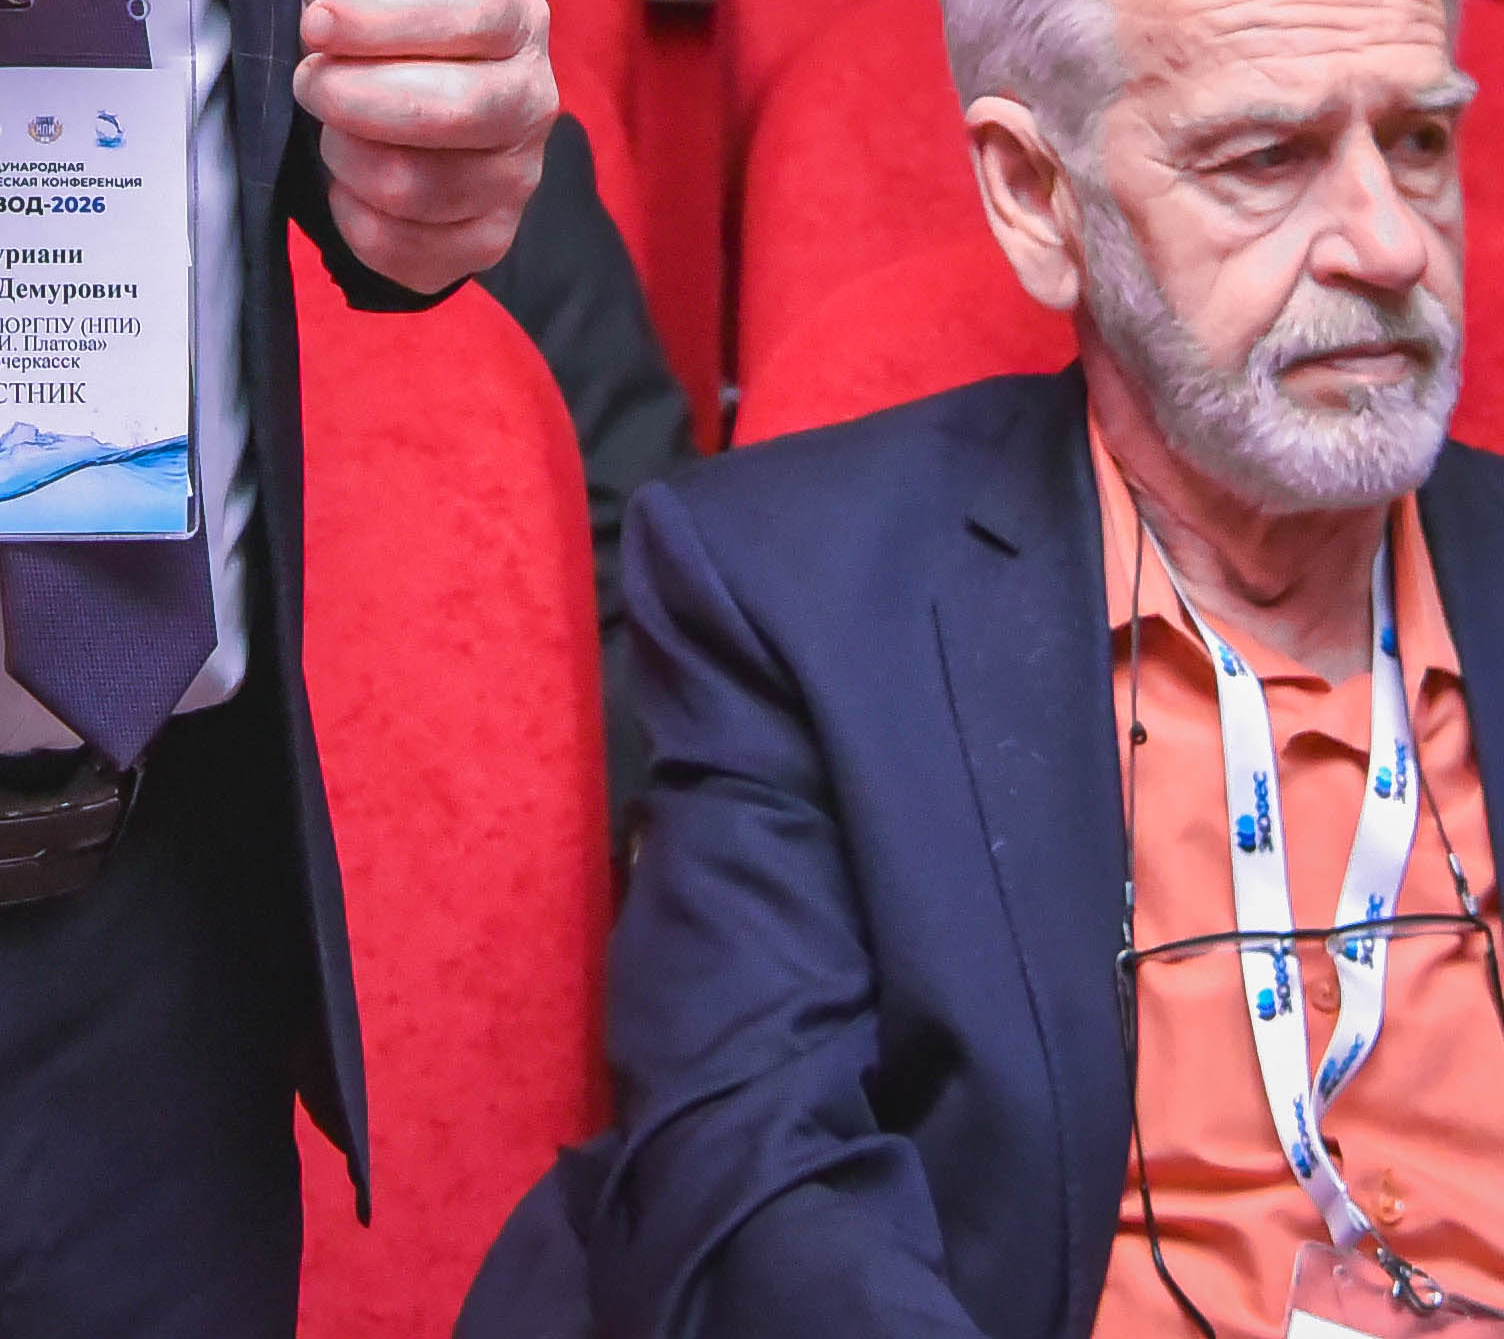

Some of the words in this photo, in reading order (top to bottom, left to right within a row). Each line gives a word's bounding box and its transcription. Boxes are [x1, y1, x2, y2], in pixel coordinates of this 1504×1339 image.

[41, 177, 142, 189] КОНФЕРЕНЦИЯ
[80, 317, 142, 337] (НПИ)
[24, 335, 108, 352] Платова»
